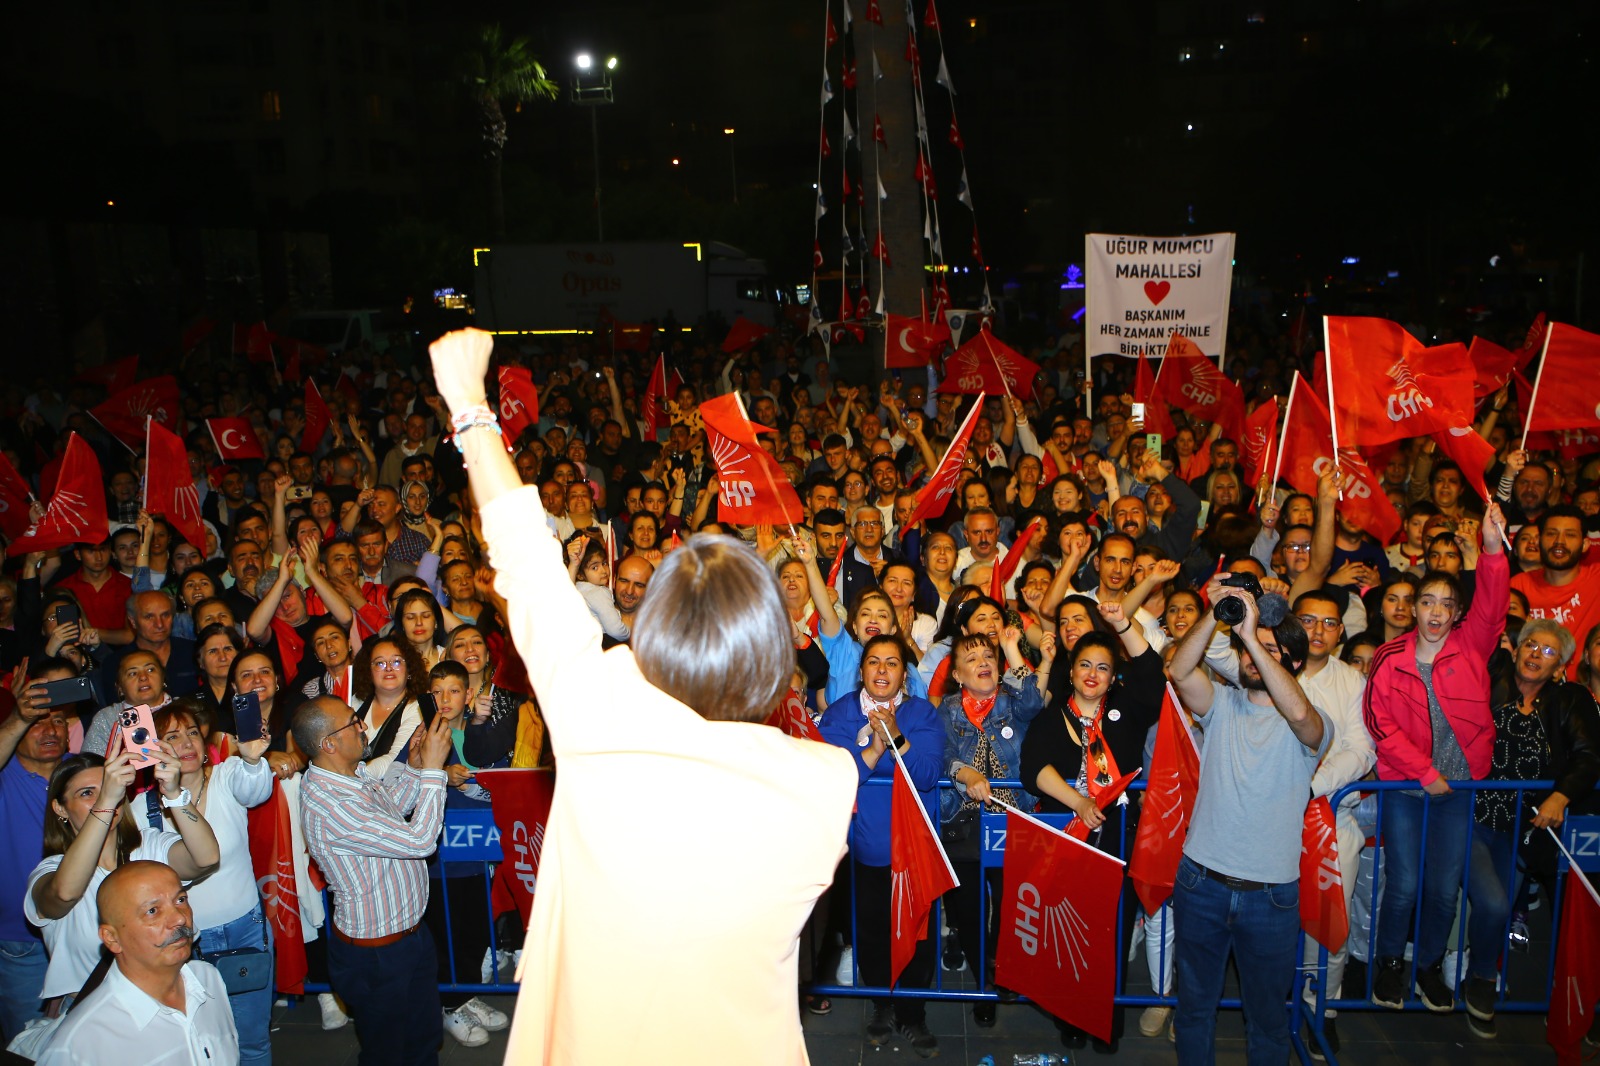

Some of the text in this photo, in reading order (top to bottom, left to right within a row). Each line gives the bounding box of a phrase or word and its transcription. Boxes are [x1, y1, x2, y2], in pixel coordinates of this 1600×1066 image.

[1106, 237, 1214, 255] UĞUR MUMCU
[1115, 259, 1202, 279] MAHALLESİ
[562, 271, 621, 297] Opus
[1125, 309, 1185, 324] BAŞKANIM
[1100, 323, 1211, 339] HER ZAMAN SİZİNLE
[1181, 383, 1217, 406] CHP
[500, 397, 525, 420] CH
[443, 822, 500, 847] İZFA
[1569, 828, 1600, 856] İZ
[513, 820, 538, 895] CHP
[1014, 882, 1041, 956] CHP
